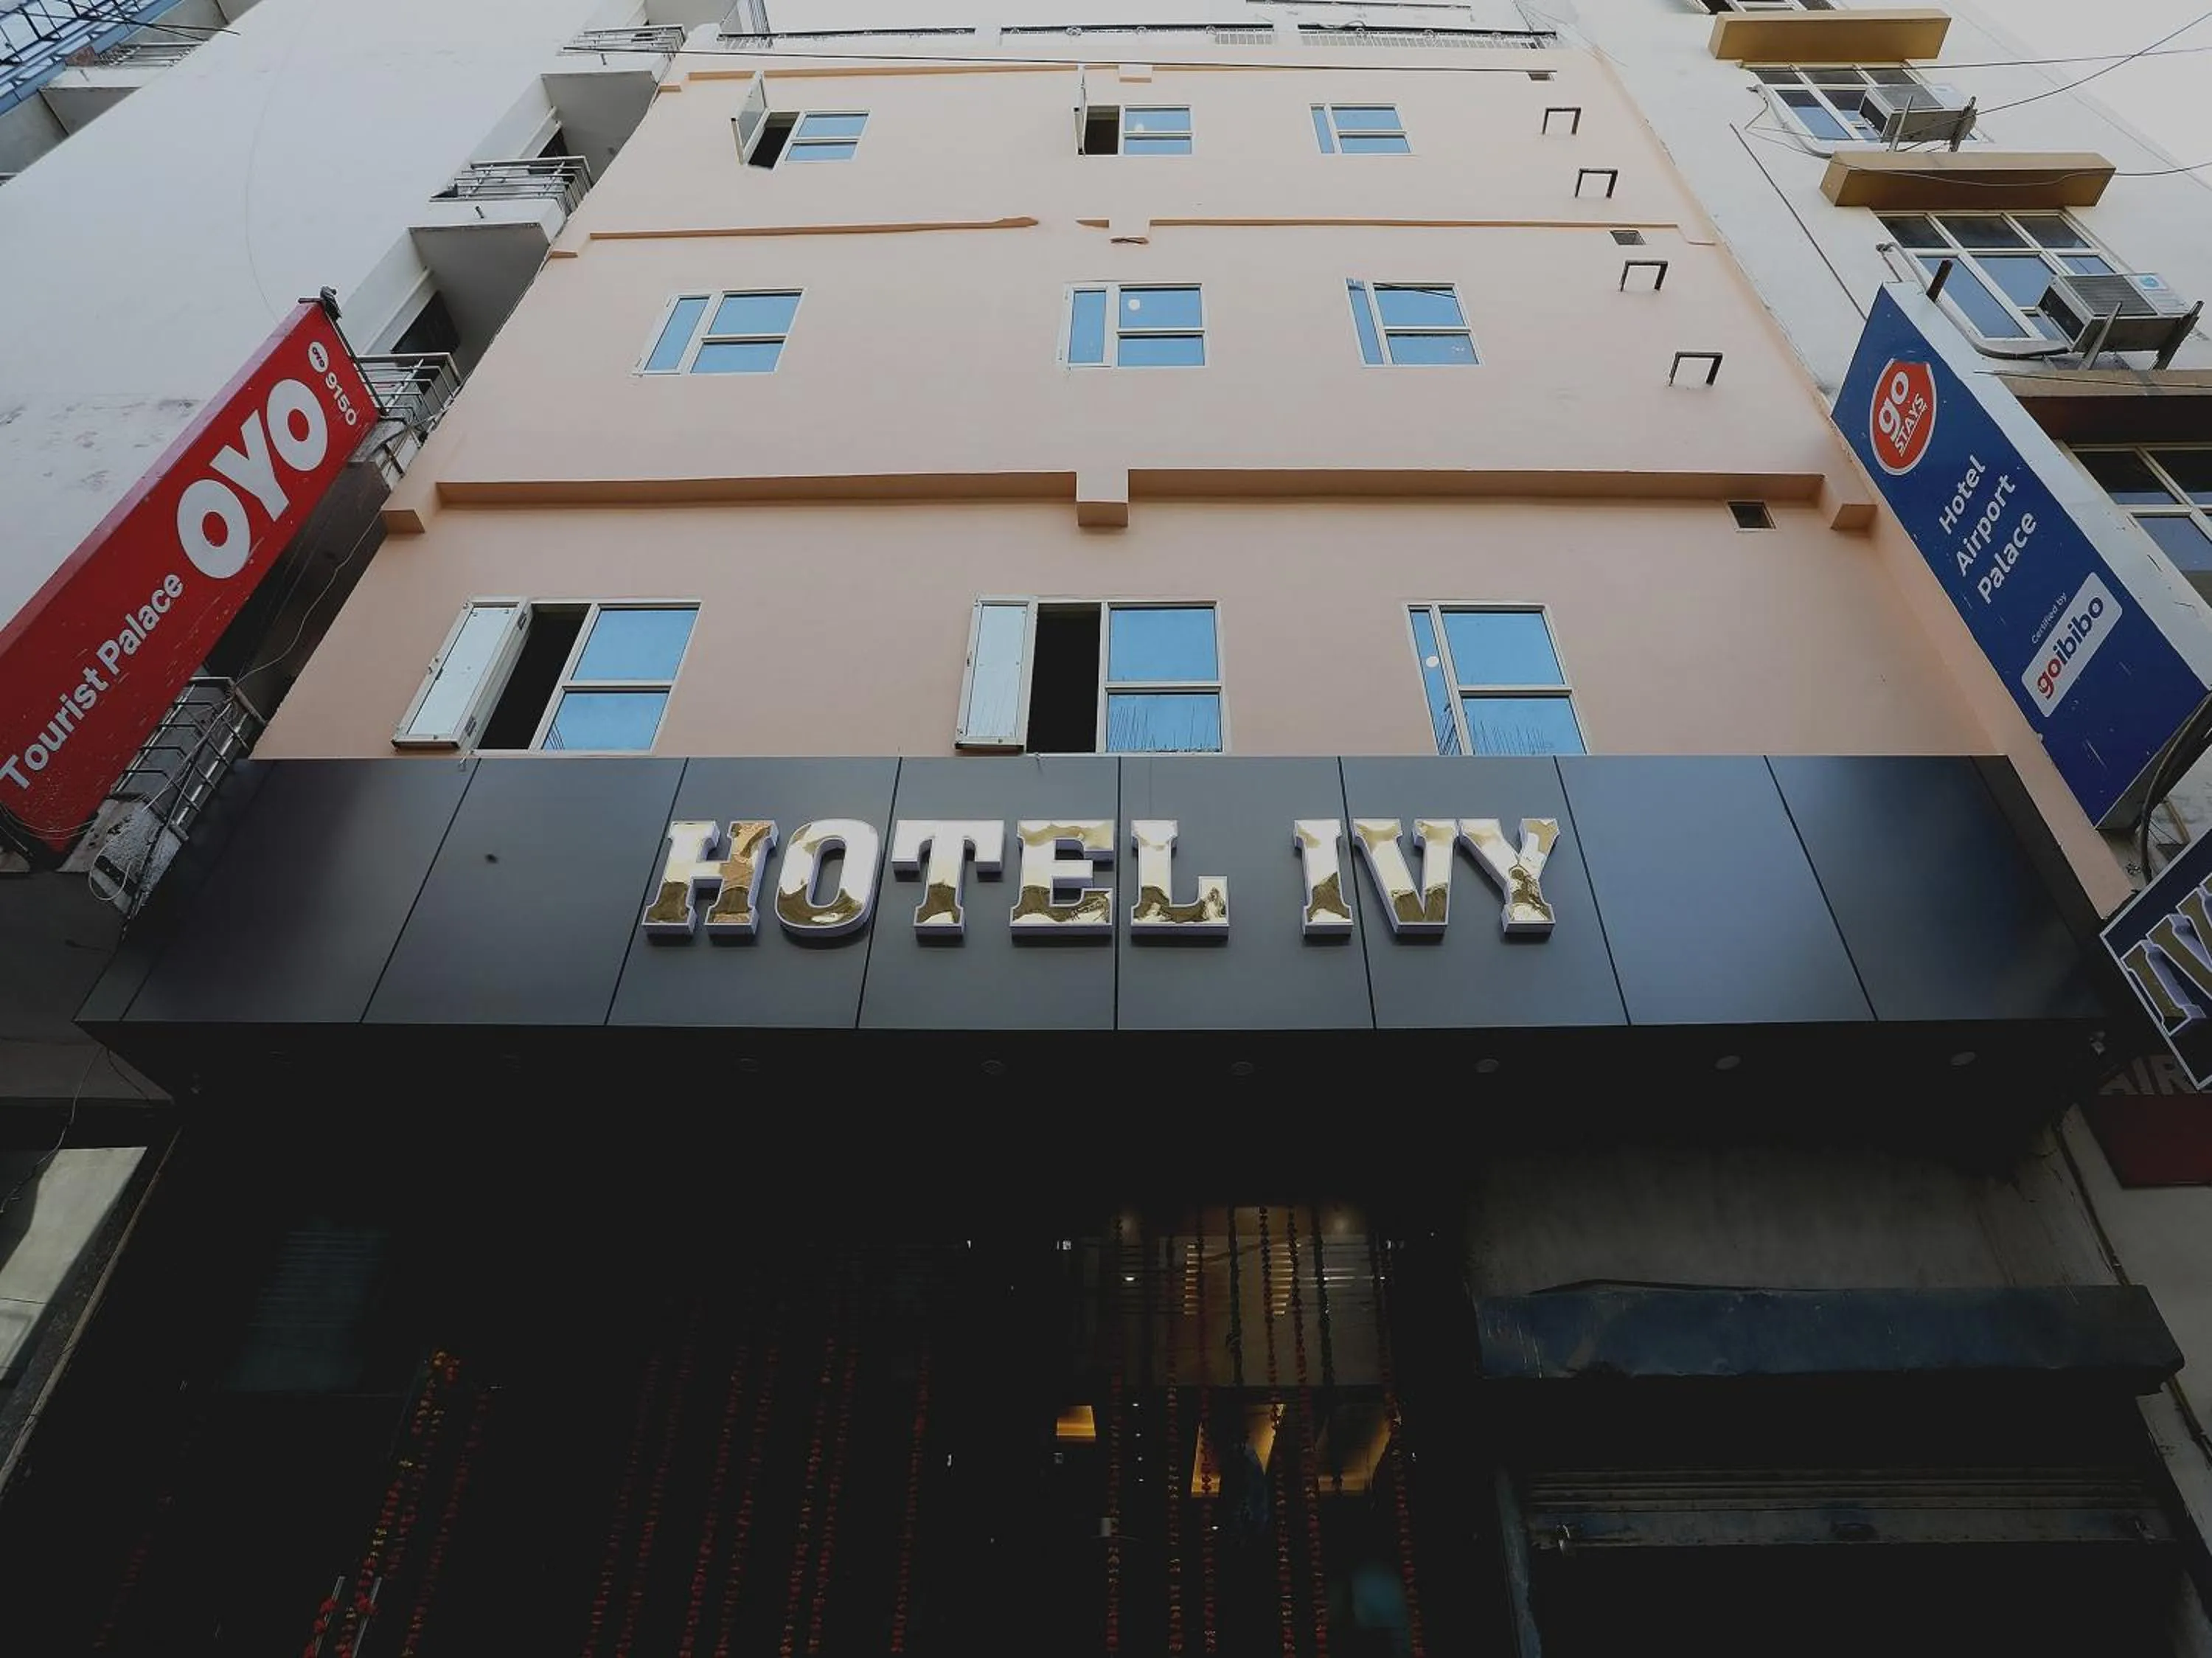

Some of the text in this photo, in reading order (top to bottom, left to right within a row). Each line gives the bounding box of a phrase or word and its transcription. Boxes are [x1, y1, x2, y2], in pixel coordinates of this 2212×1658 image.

[325, 371, 357, 426] 9150
[1878, 371, 1909, 443] go
[1895, 393, 1928, 457] STAYS
[177, 378, 328, 579] OYO
[1938, 454, 1986, 535] Hotel
[1956, 474, 2016, 577] Airport
[1977, 513, 2037, 605] Palace
[2031, 592, 2067, 644] Certified by
[2037, 597, 2104, 700] goibibo
[0, 574, 184, 790] Tourist Palace
[640, 818, 1562, 940] HOTEL IVY
